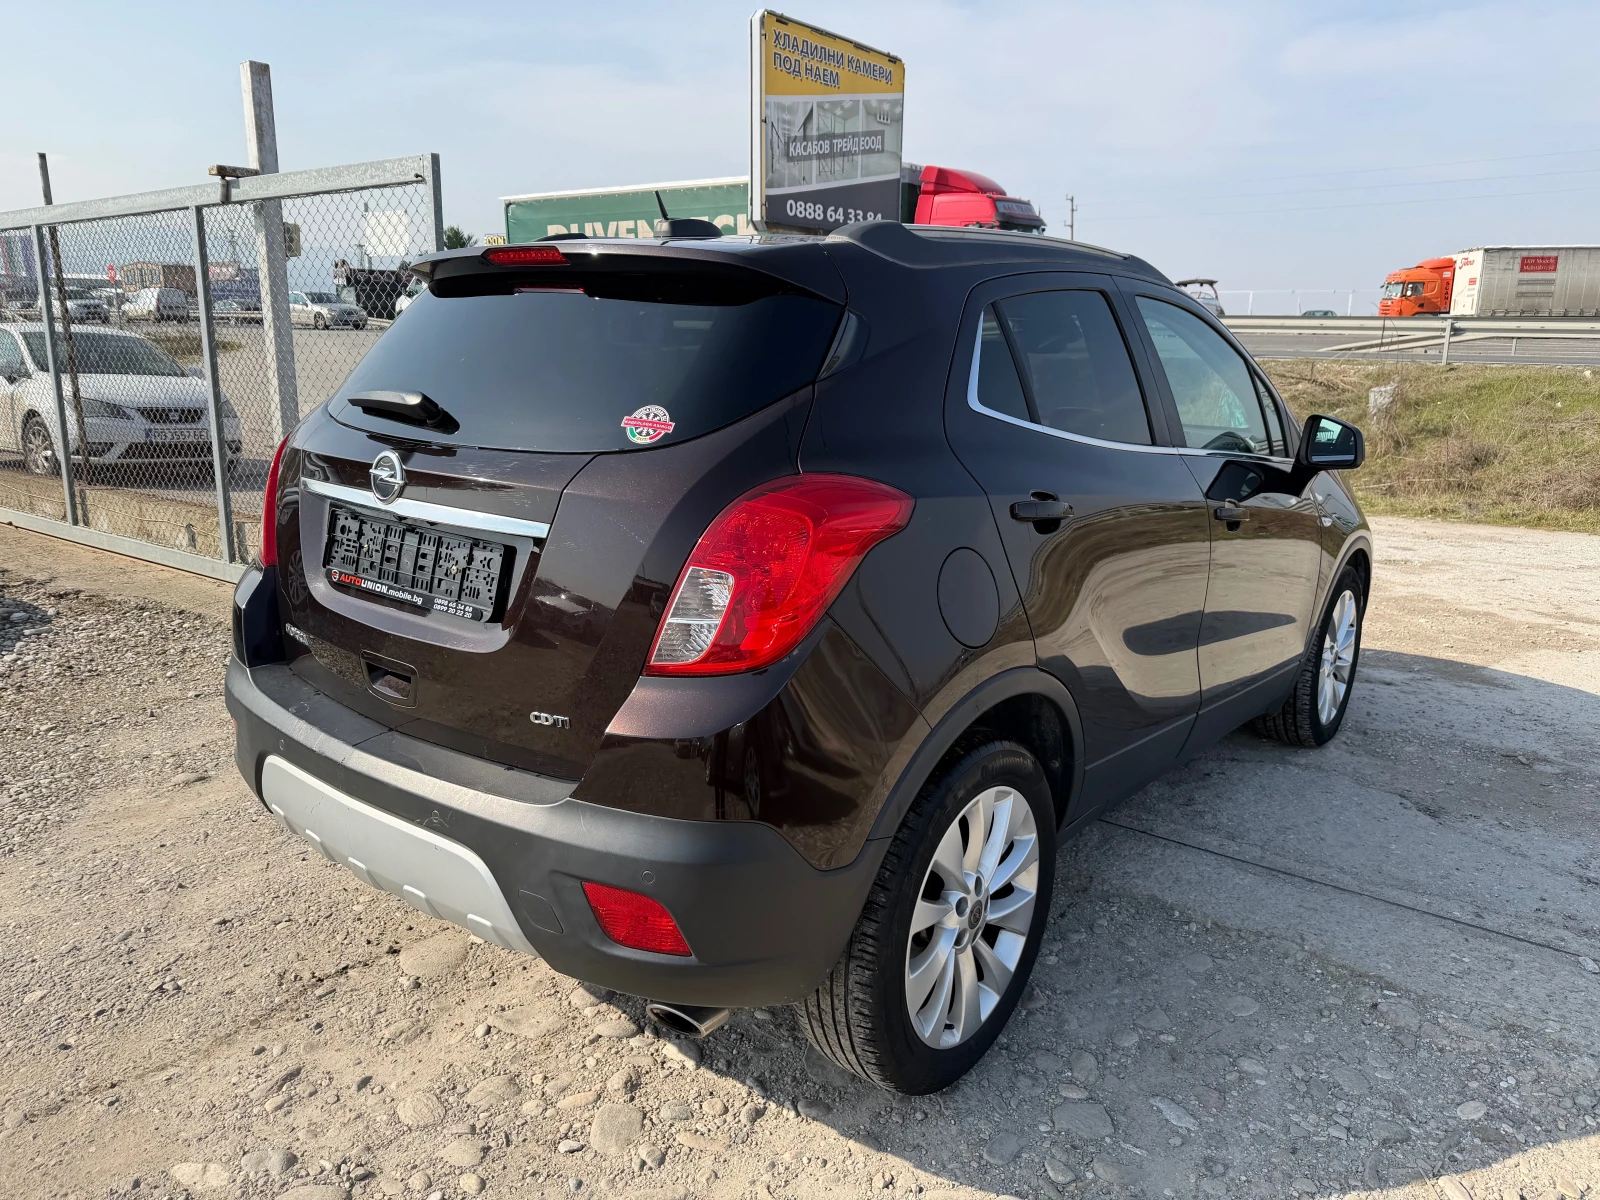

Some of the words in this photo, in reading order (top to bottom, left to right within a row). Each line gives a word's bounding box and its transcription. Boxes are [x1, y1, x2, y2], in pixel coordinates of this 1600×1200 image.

[772, 29, 845, 68] ХЛАДИЛНИ
[847, 55, 893, 84] КАМЕРИ
[773, 52, 802, 79] ПОД
[805, 63, 840, 87] НАЕМ
[789, 140, 830, 156] КАСАБОВ
[833, 135, 858, 153] ТРЕЙД
[860, 136, 882, 151] ЕООД
[786, 199, 824, 220] 0888
[827, 206, 844, 223] 64
[847, 209, 863, 224] 33
[339, 573, 423, 605] AUTOUNION.mobile.bg
[530, 711, 570, 729] CDTI
